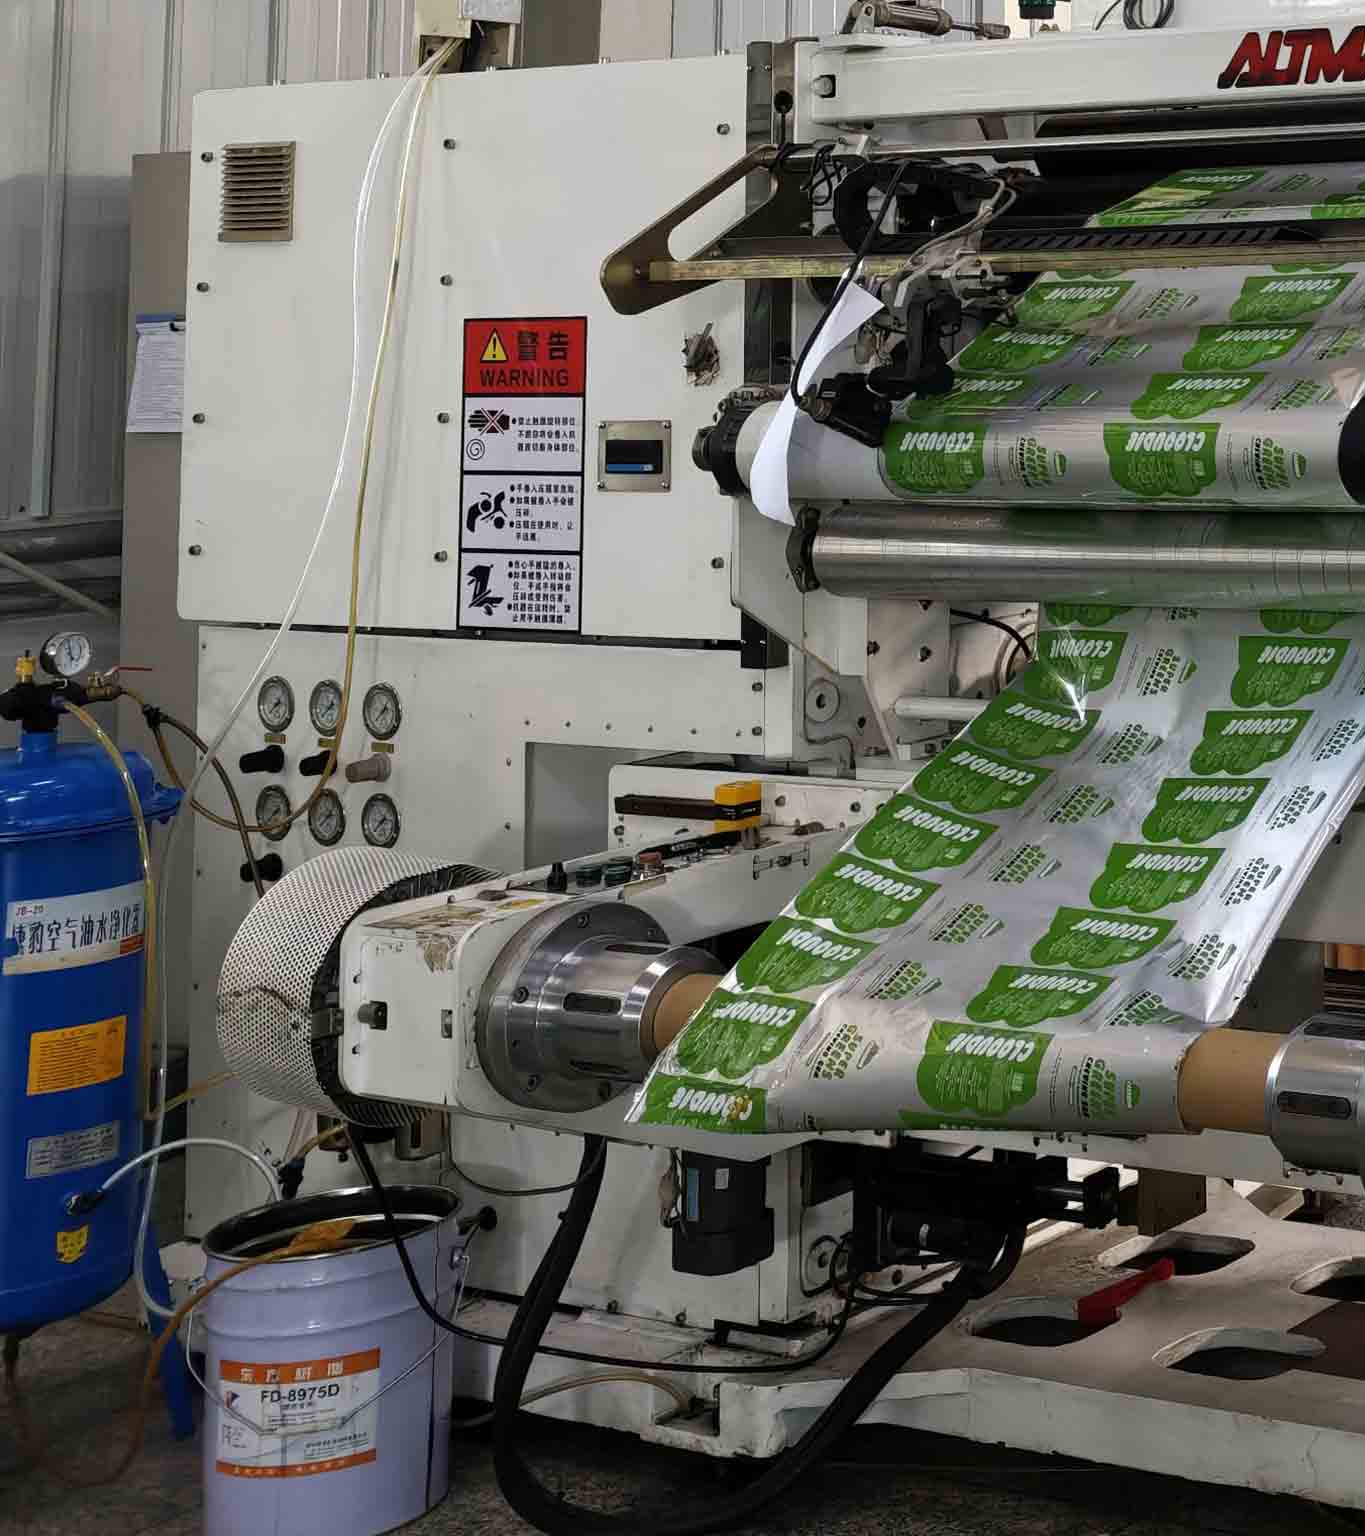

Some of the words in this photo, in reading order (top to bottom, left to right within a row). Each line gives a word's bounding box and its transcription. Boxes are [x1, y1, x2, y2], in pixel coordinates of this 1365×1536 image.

[517, 329, 569, 362] 警告
[480, 368, 569, 387] WARNING
[261, 1383, 339, 1404] FD-8975D
